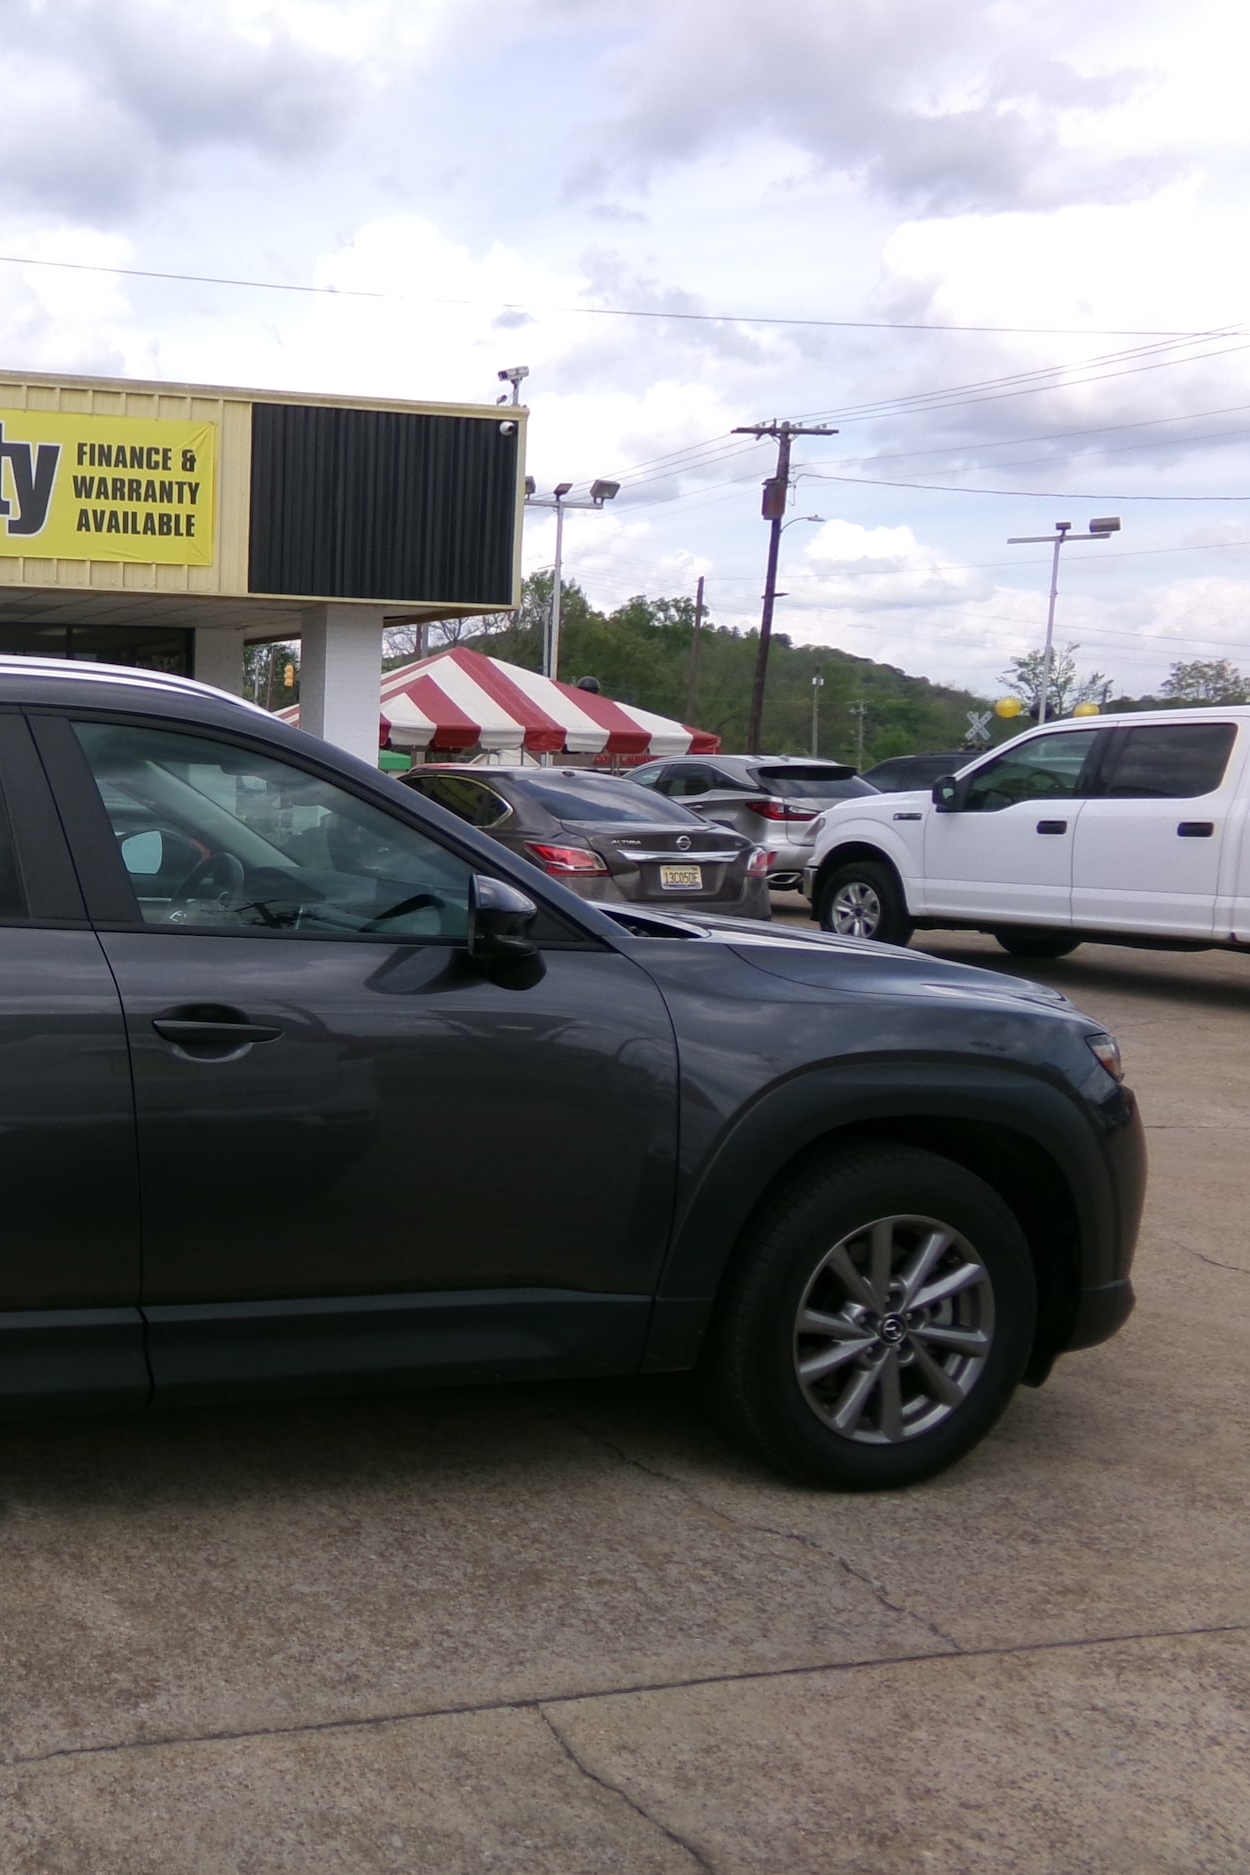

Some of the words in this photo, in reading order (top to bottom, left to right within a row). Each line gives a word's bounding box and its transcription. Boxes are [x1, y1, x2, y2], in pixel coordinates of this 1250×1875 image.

[77, 442, 172, 471] FINANCE
[181, 449, 196, 472] &
[72, 475, 200, 505] WARRANTY
[76, 509, 195, 537] AVAILABLE
